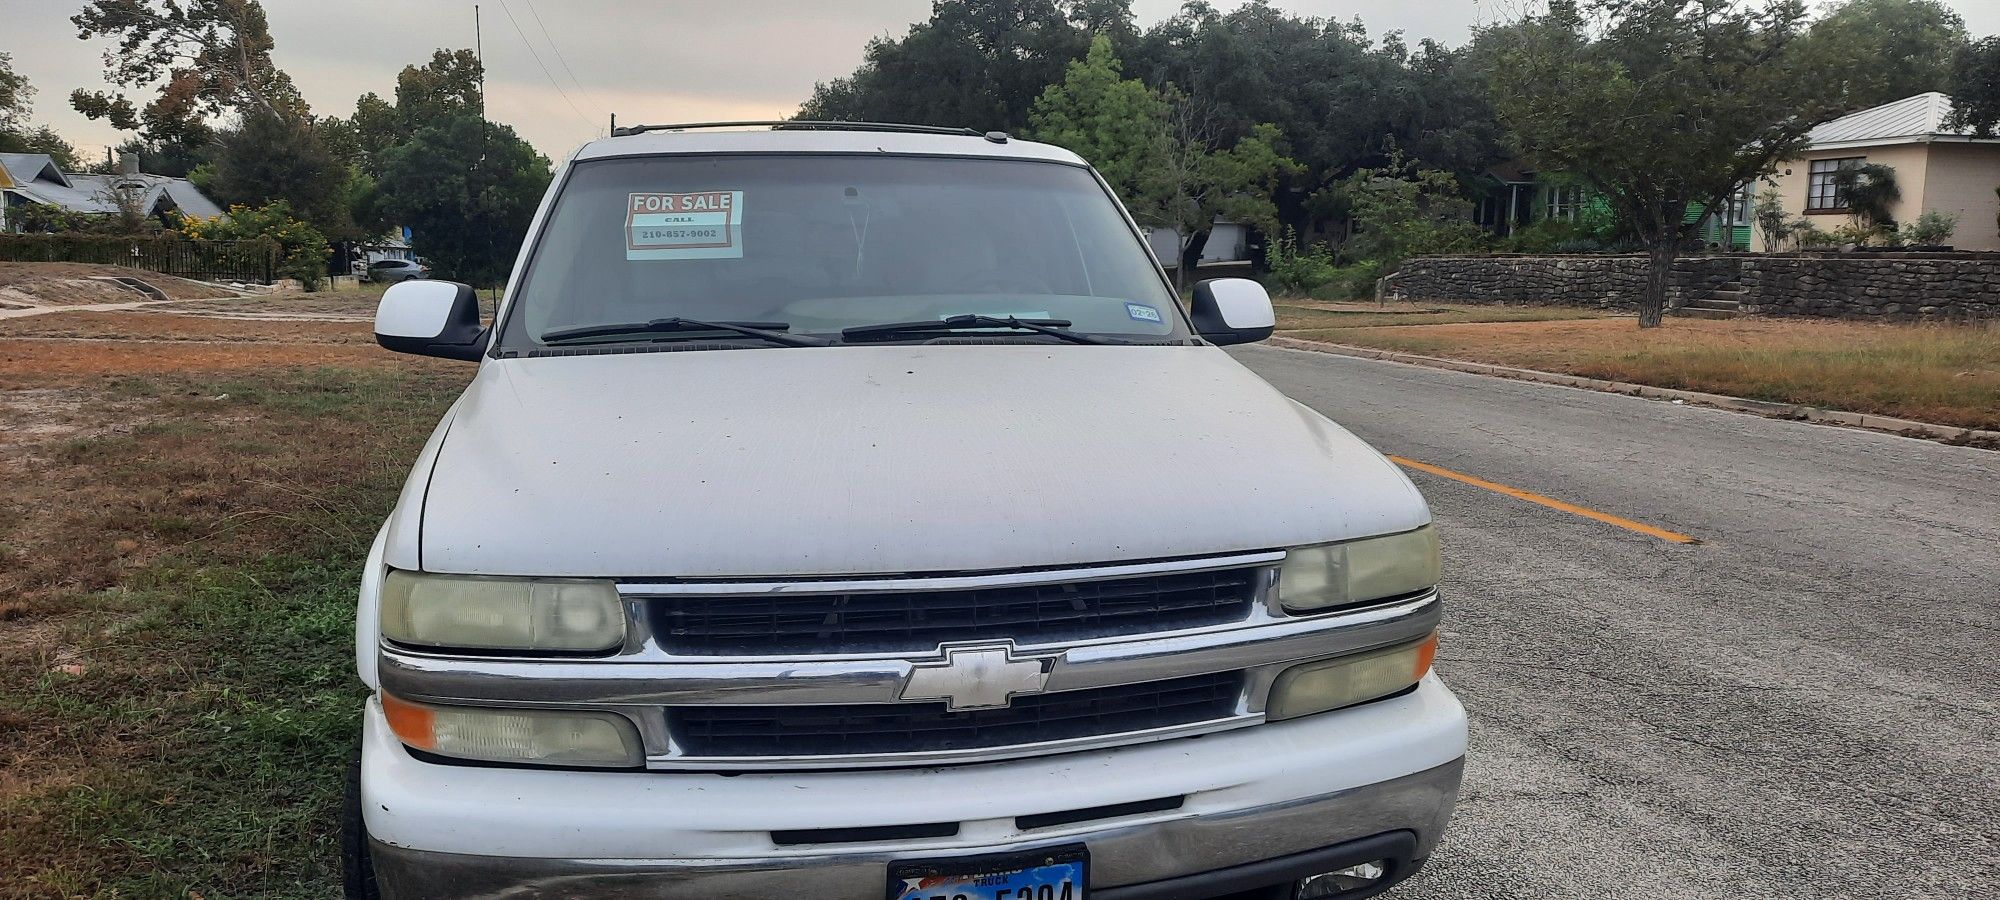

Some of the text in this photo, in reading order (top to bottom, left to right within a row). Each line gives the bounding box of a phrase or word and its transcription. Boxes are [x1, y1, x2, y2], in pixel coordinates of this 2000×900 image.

[634, 195, 730, 211] FOR SALE
[642, 230, 717, 239] 210-857-9002
[974, 876, 1008, 887] TRUCK
